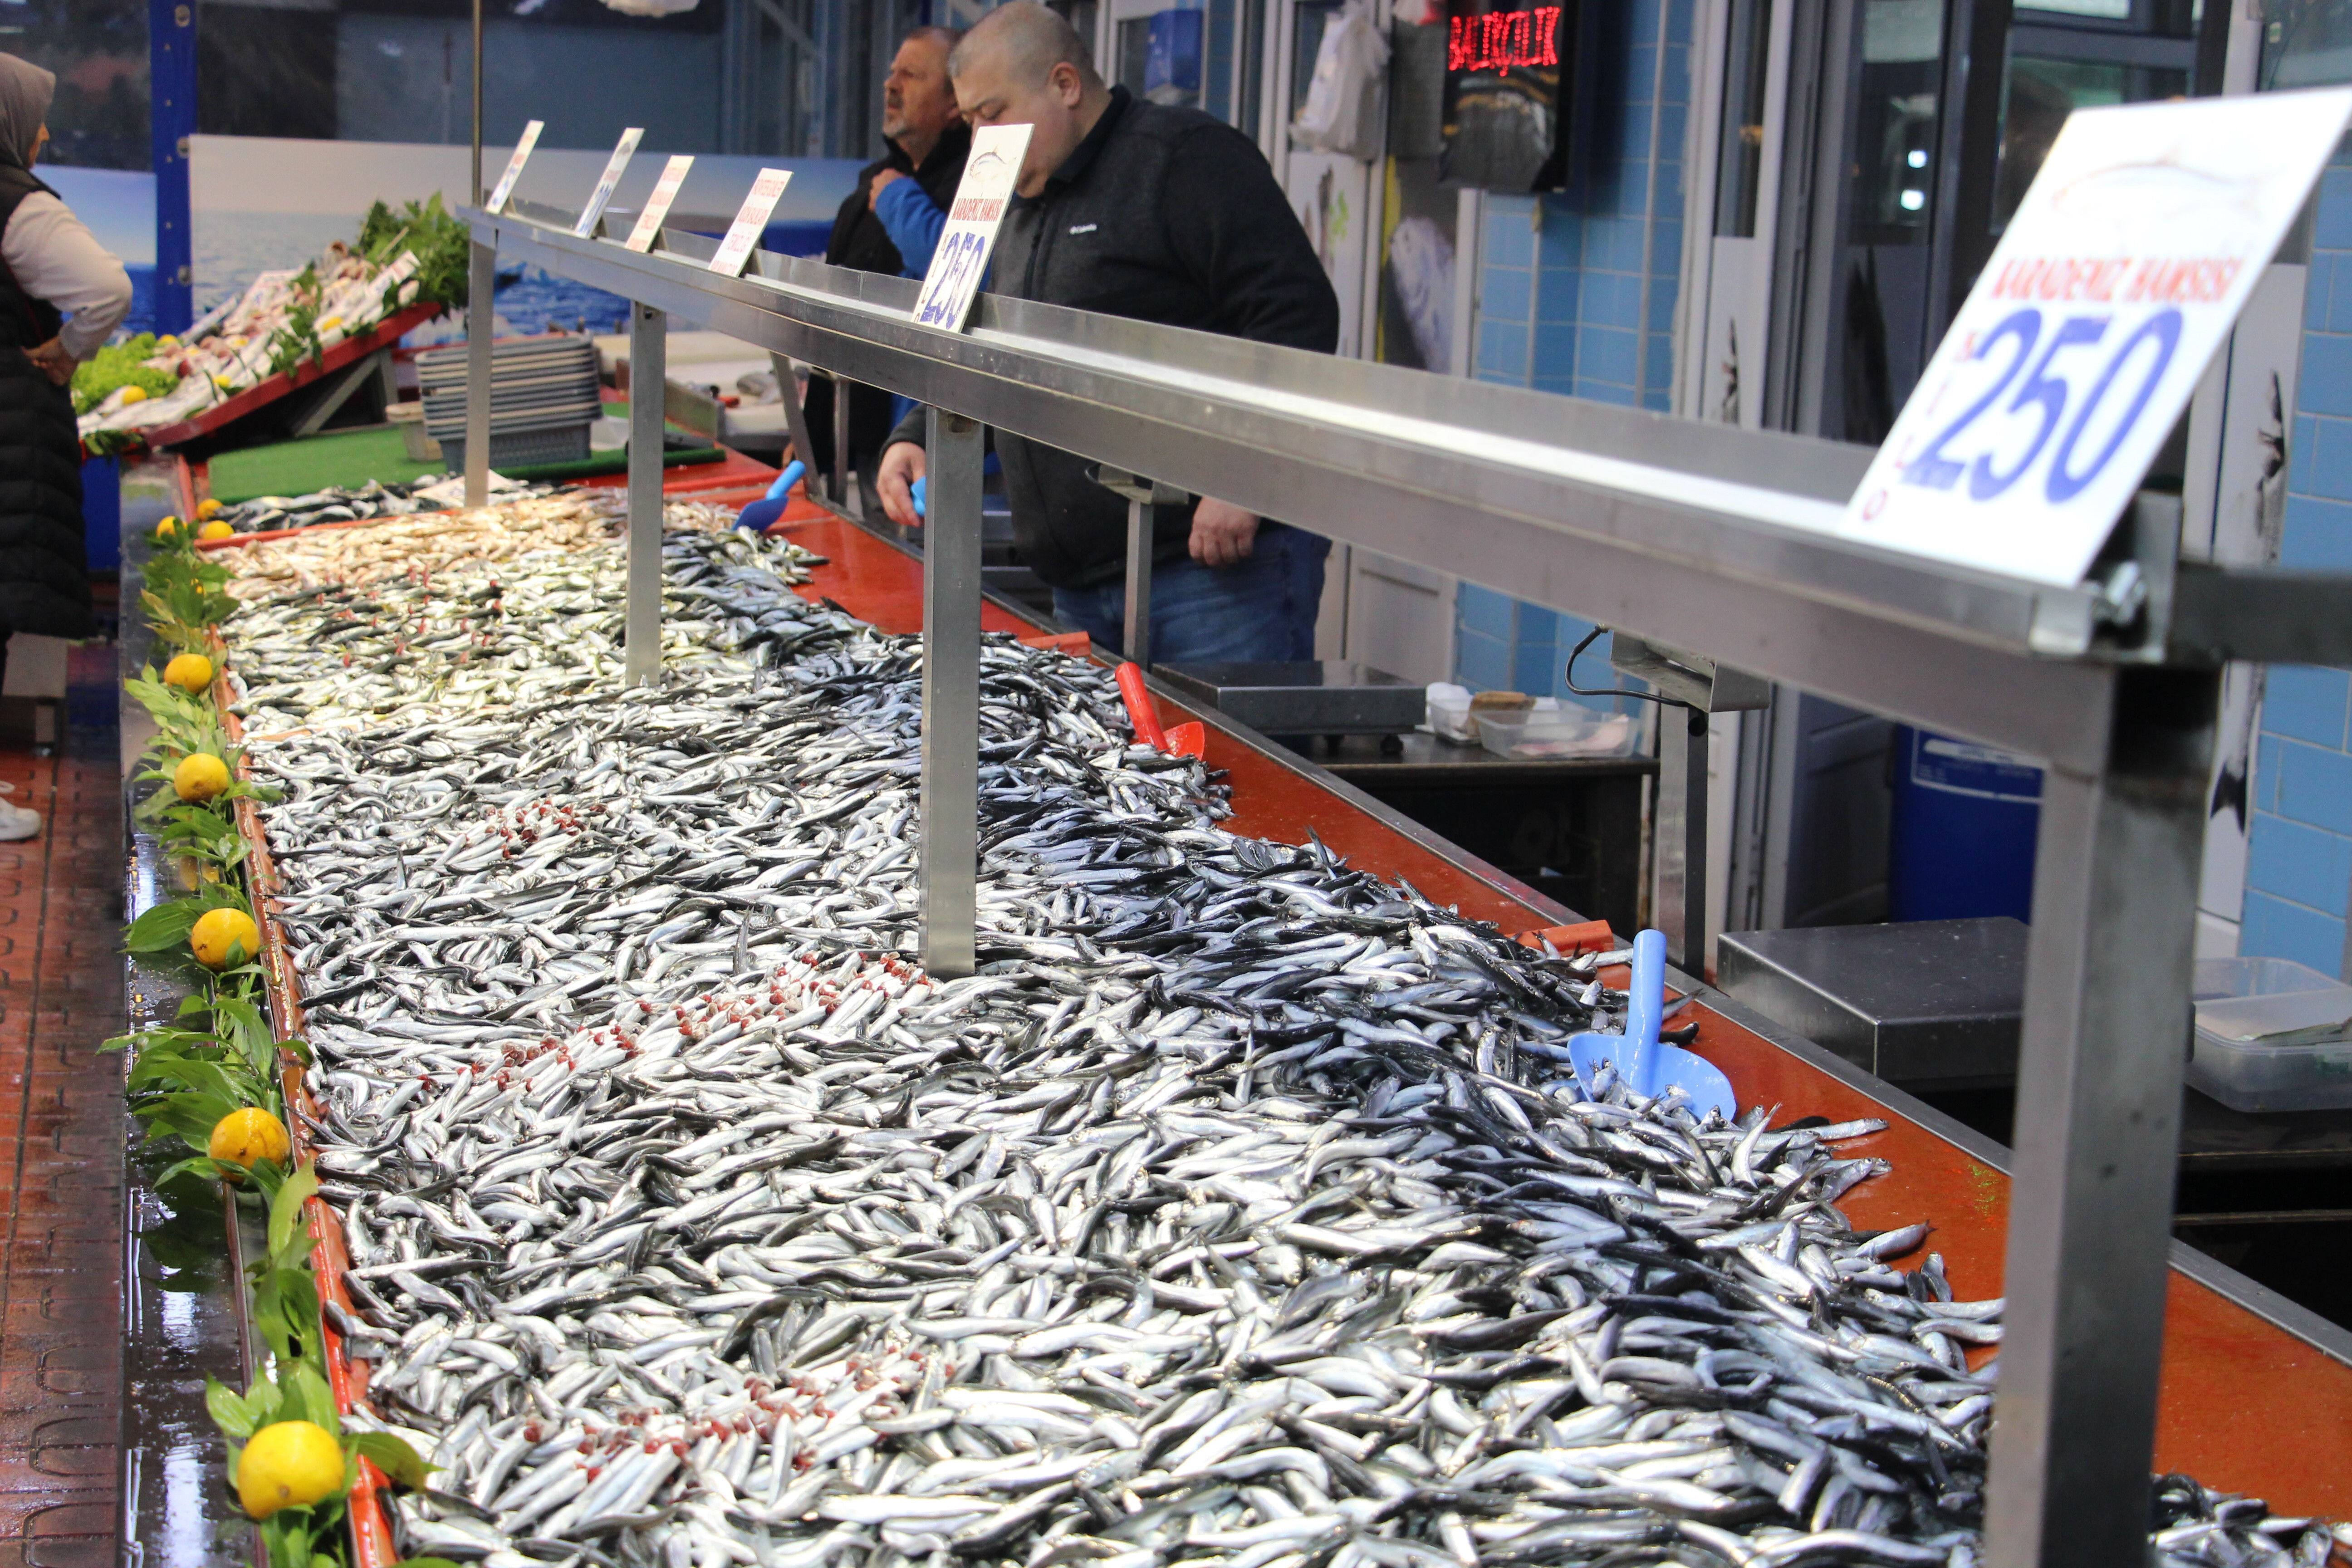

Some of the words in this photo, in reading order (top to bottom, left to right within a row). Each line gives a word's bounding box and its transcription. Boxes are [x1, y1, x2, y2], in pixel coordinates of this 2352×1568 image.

[951, 192, 984, 221] KARADENİZ
[978, 192, 1006, 222] HAMSİSİ
[920, 232, 985, 330] 250
[1900, 309, 2183, 505] 250
